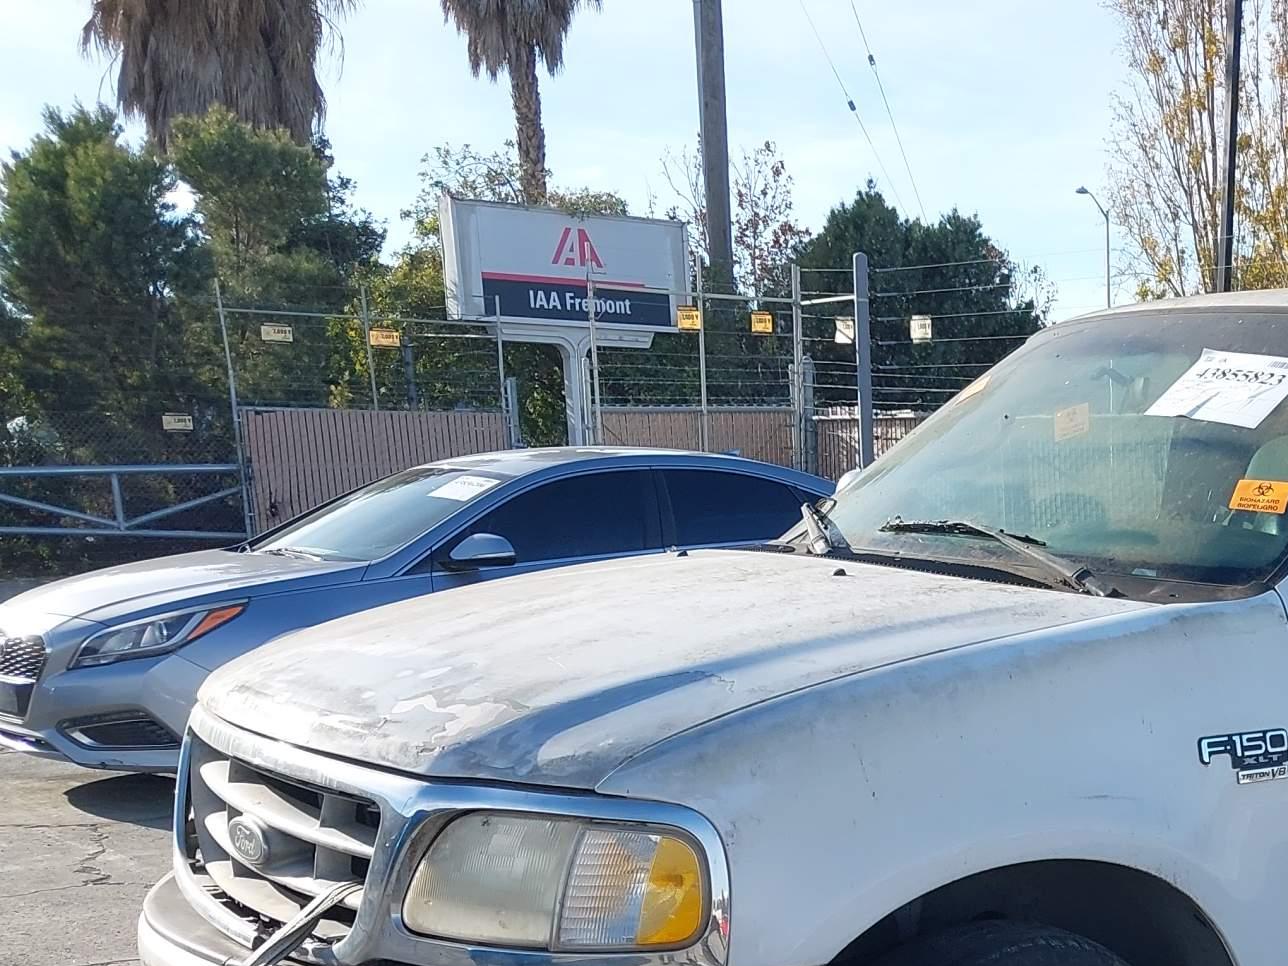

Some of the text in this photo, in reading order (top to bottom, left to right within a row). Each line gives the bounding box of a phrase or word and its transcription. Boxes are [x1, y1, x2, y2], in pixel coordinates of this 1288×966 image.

[529, 289, 632, 315] IAA Fremont
[1196, 367, 1287, 386] 43855823
[1236, 503, 1279, 511] BIOPELIGRO
[1239, 496, 1281, 505] BIOHAZARD
[1242, 754, 1283, 765] XLT
[1240, 767, 1286, 780] TRITON V8
[234, 825, 256, 856] Ford
